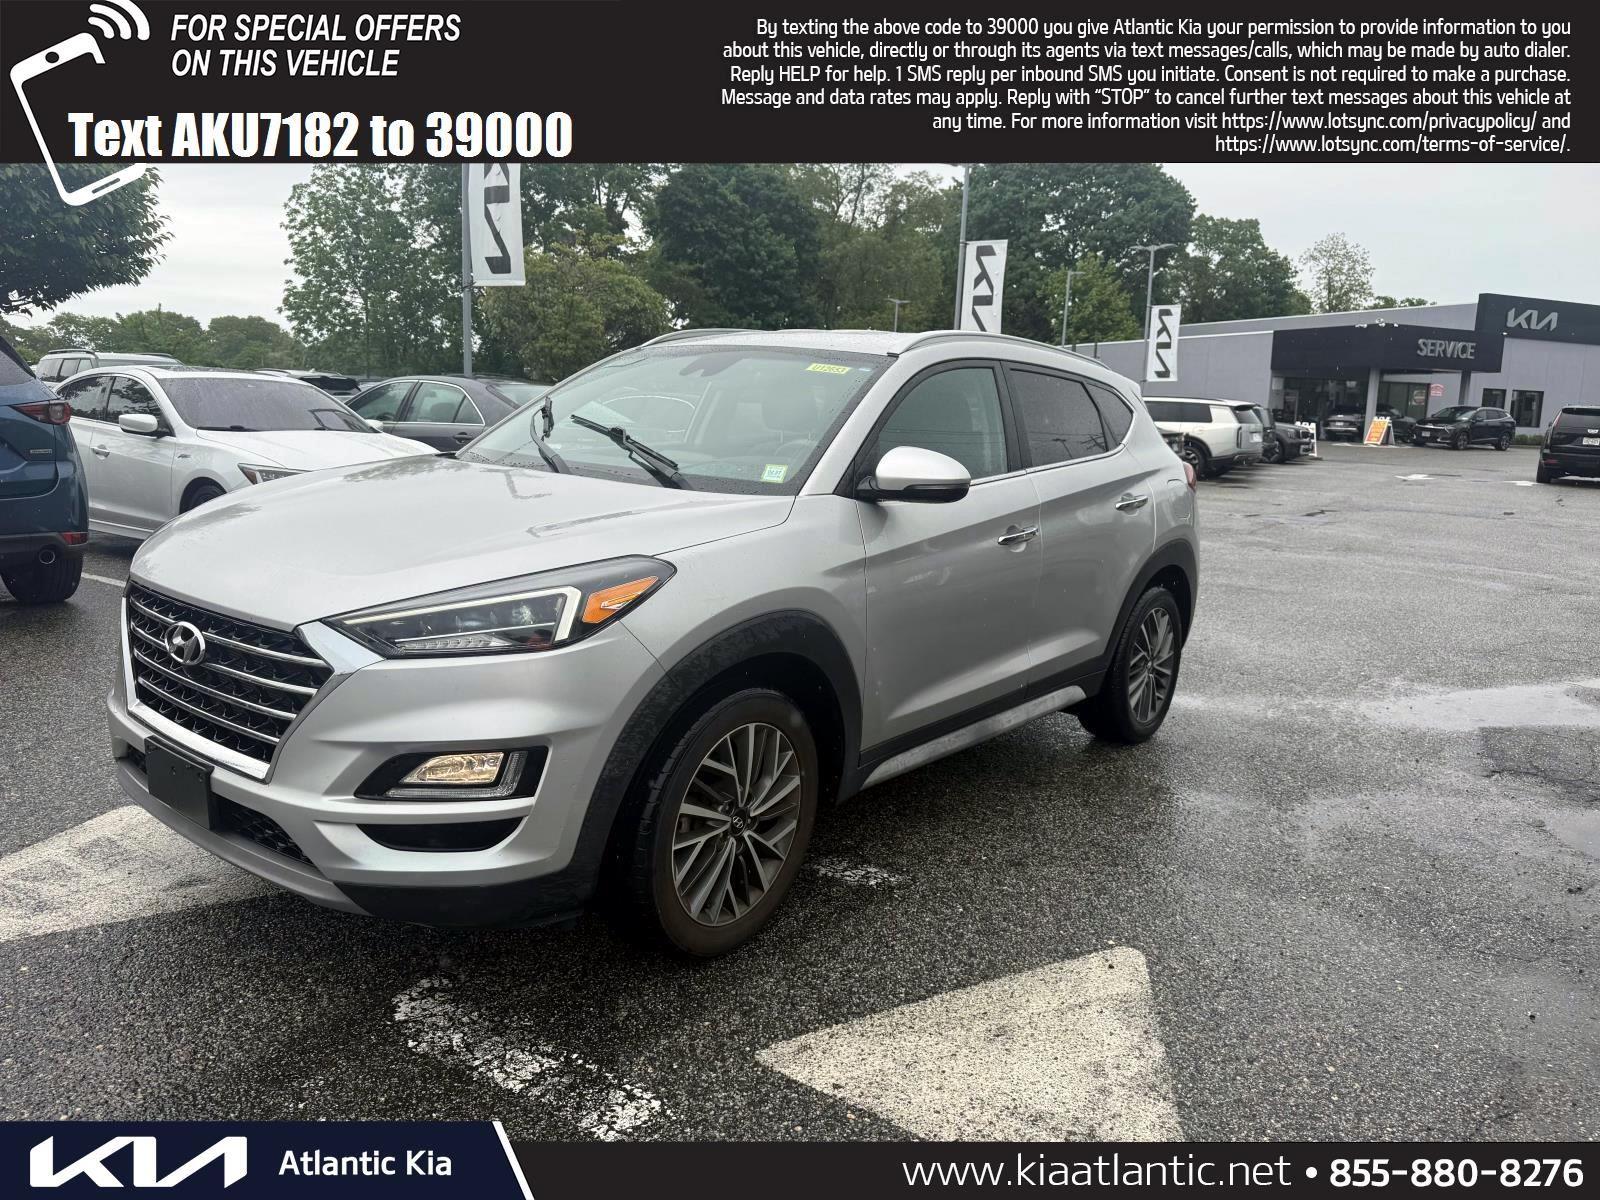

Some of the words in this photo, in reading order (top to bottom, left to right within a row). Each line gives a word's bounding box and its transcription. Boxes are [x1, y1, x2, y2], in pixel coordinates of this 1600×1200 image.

[1506, 307, 1558, 332] KIA
[1154, 308, 1173, 378] KIA
[1416, 338, 1477, 359] SERVICE
